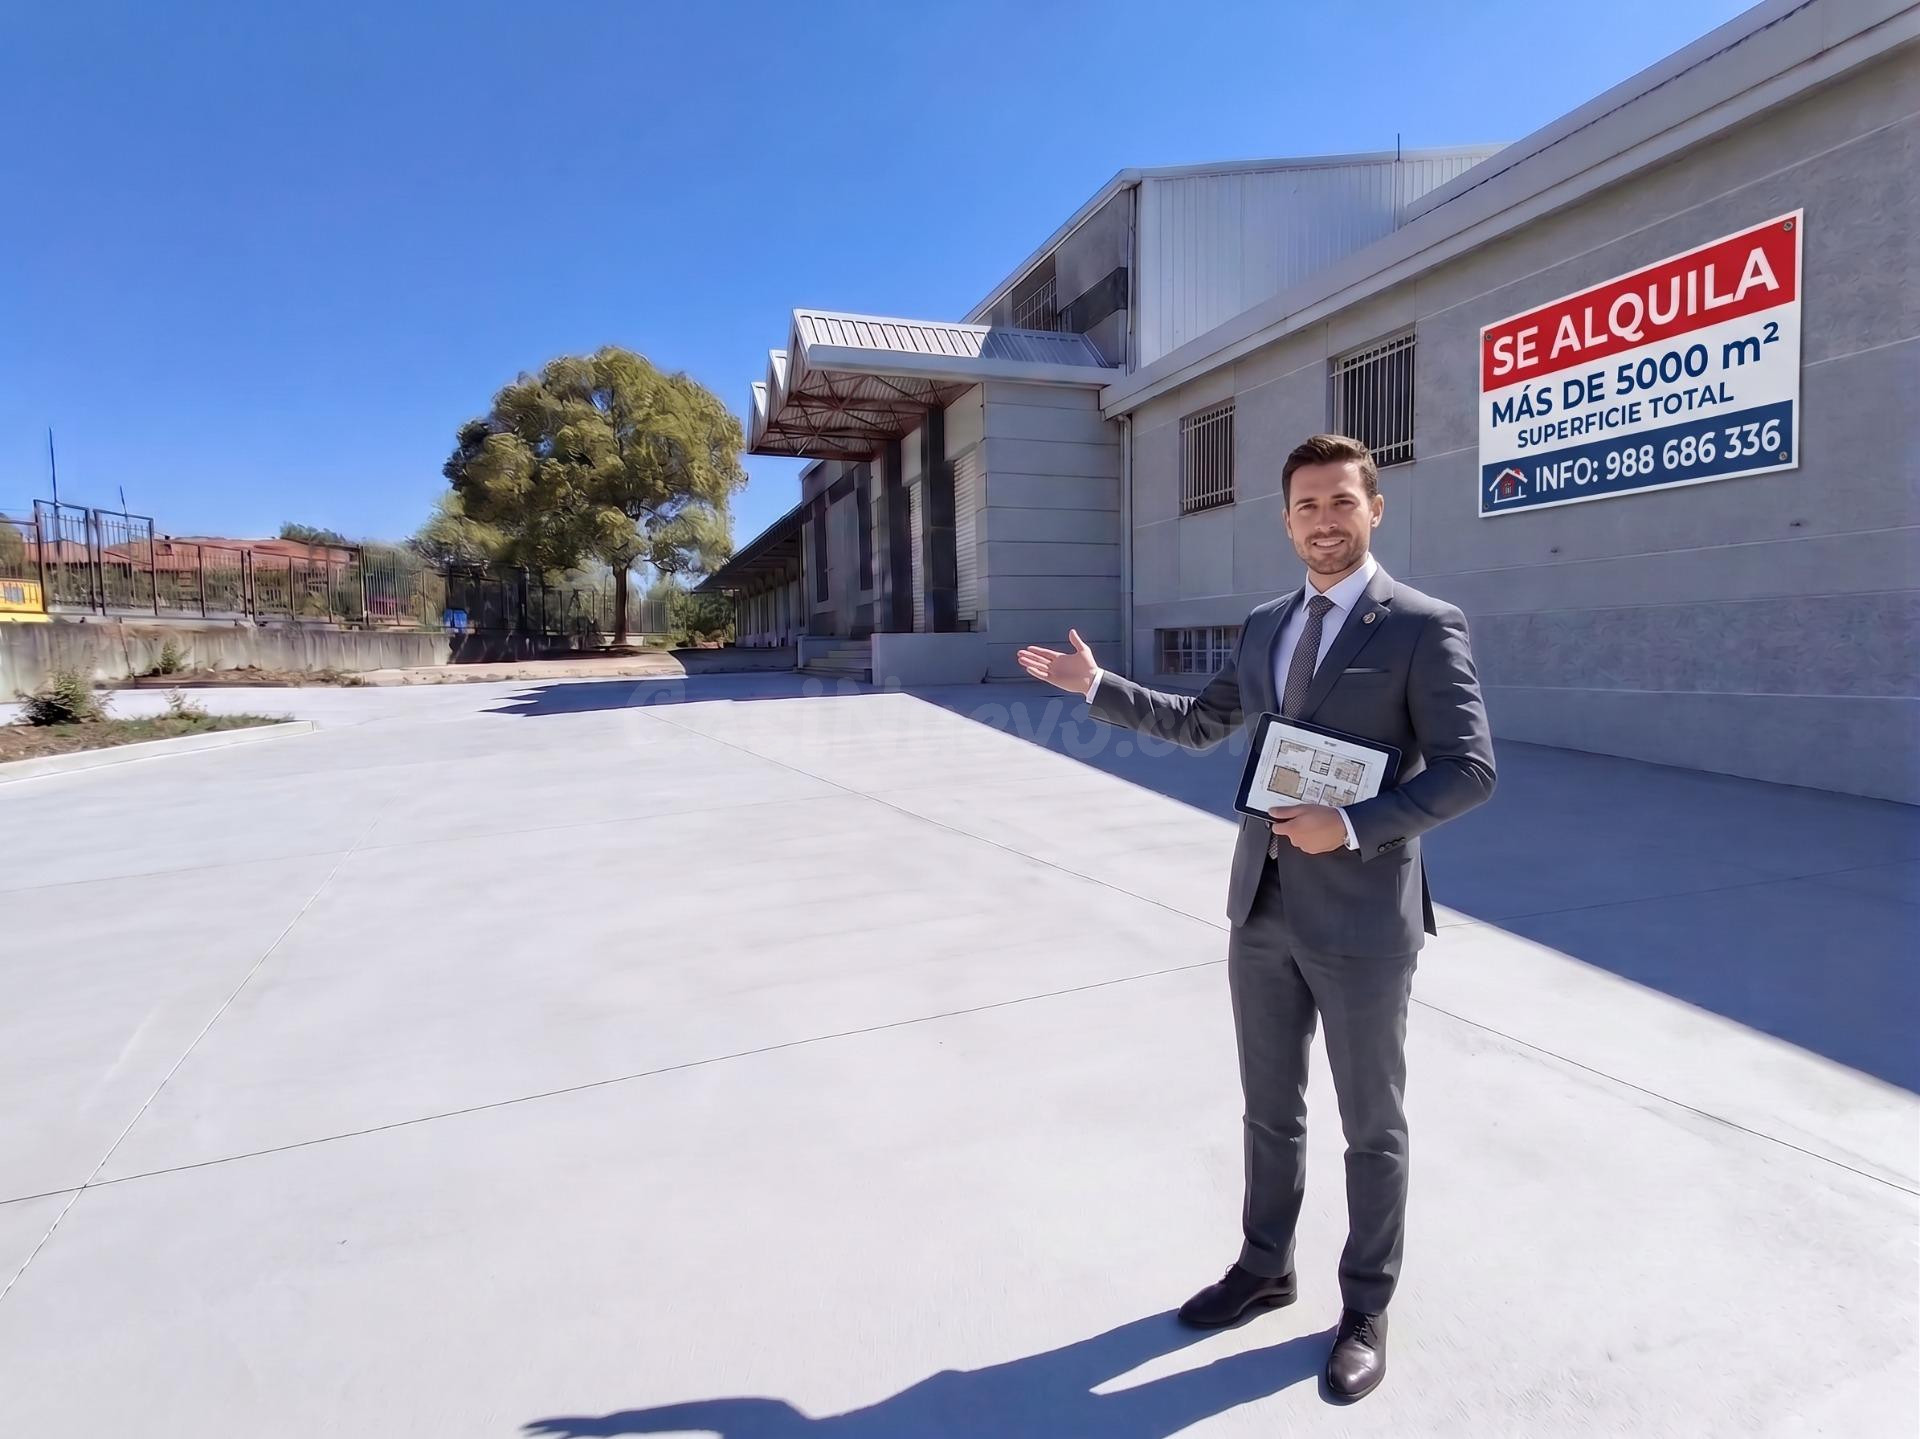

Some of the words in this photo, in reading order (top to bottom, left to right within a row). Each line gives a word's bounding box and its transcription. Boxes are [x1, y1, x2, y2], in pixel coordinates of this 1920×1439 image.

[1492, 326, 1539, 376] SE
[1550, 246, 1780, 359] ALQUILA
[1491, 384, 1553, 428] MÁS
[1563, 371, 1605, 410] DE
[1616, 343, 1708, 395] 5000
[1517, 402, 1641, 448] SUPERFICIE
[1649, 382, 1734, 418] TOTAL
[1535, 456, 1599, 493] INFO:
[1605, 445, 1655, 480] 988
[1663, 432, 1716, 470] 686
[1724, 418, 1781, 459] 336
